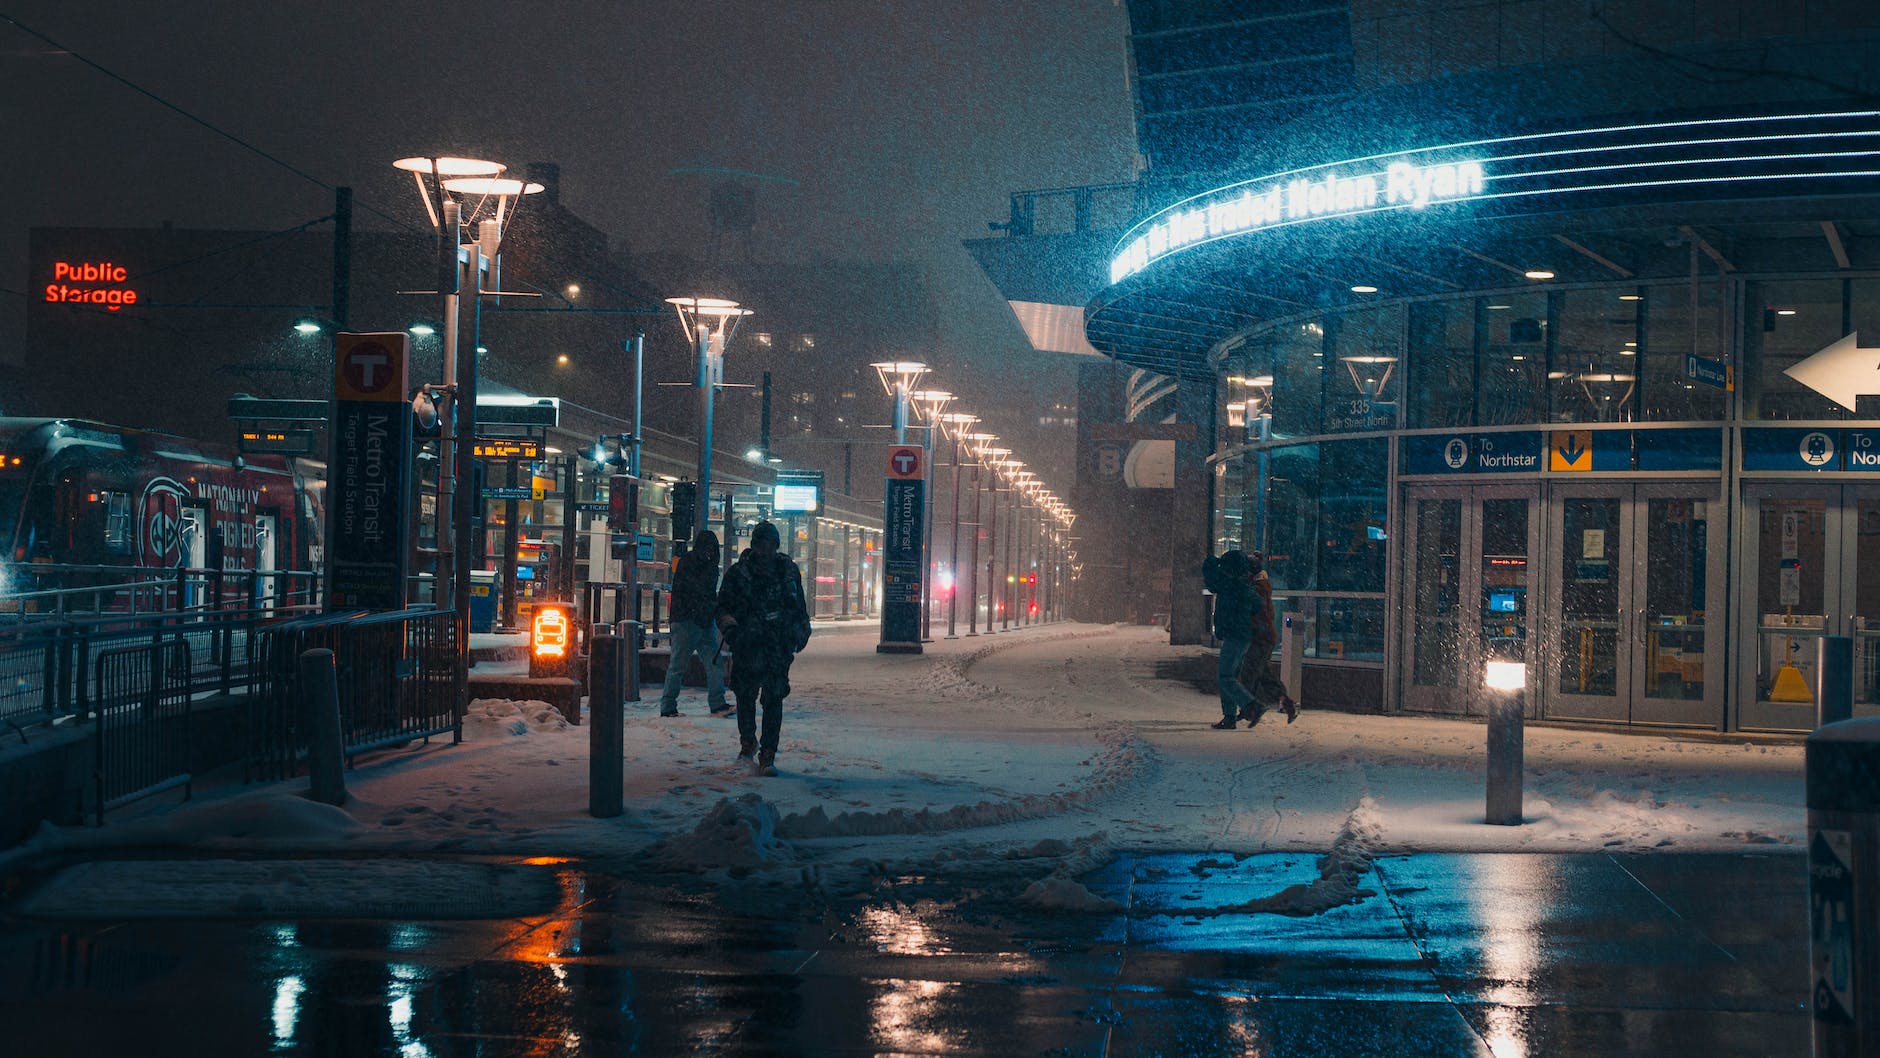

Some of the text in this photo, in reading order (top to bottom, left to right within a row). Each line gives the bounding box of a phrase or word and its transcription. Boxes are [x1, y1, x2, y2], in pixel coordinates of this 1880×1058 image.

[1288, 173, 1376, 219] Nolan
[1387, 161, 1483, 210] Ryan
[54, 261, 127, 282] Public
[45, 283, 137, 311] Storage
[351, 354, 387, 387] T
[1350, 400, 1369, 414] 335
[1344, 416, 1366, 428] Street
[1367, 415, 1388, 427] North
[1479, 438, 1493, 451] To
[1852, 433, 1872, 447] To
[895, 455, 914, 473] T
[1479, 454, 1537, 467] Northstar
[343, 412, 360, 535] Target Field Station
